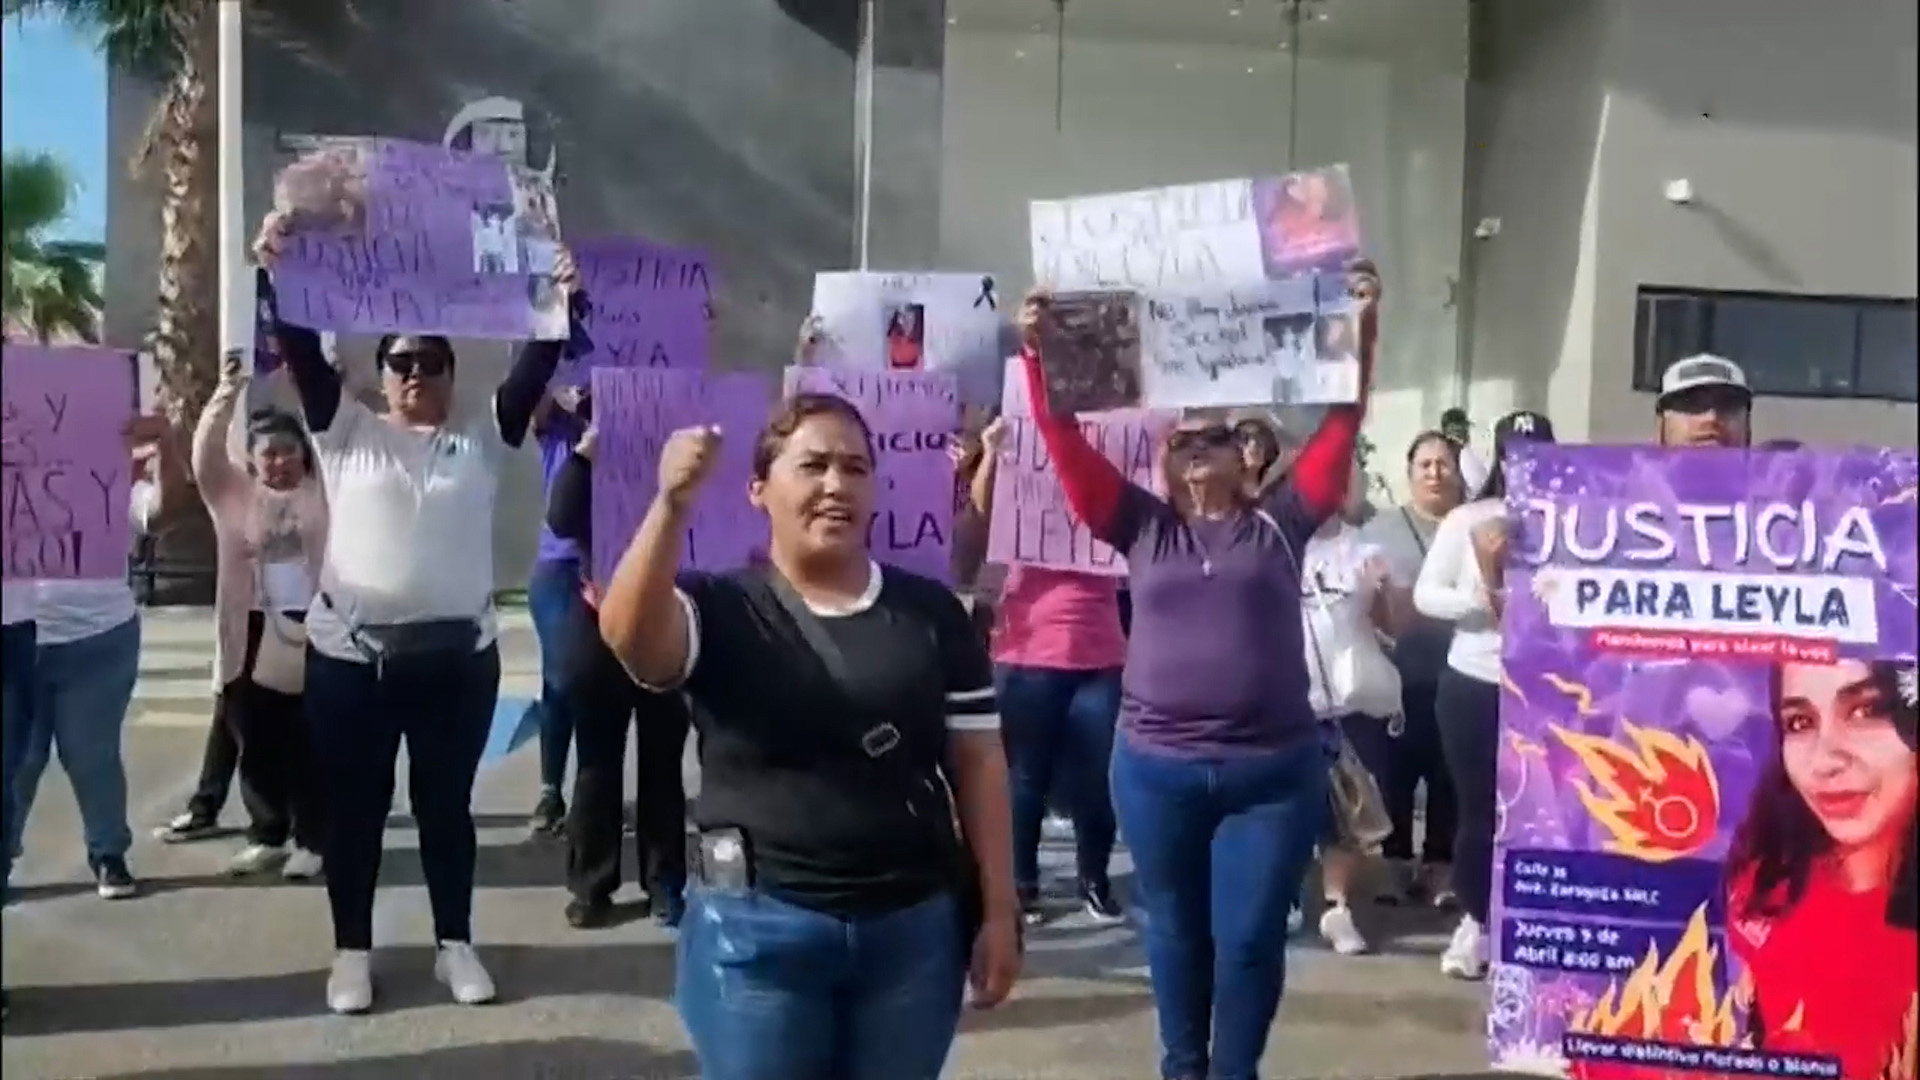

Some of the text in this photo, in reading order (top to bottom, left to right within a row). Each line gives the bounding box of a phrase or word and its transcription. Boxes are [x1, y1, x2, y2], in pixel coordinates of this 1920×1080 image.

[1004, 416, 1153, 486] JUTICIA
[1525, 499, 1887, 571] JUSTICIA
[1575, 579, 1851, 629] PARA LEYLA
[1514, 920, 1575, 942] Jueves
[1596, 928, 1620, 946] de
[1514, 946, 1558, 963] Abril
[1605, 955, 1635, 969] am
